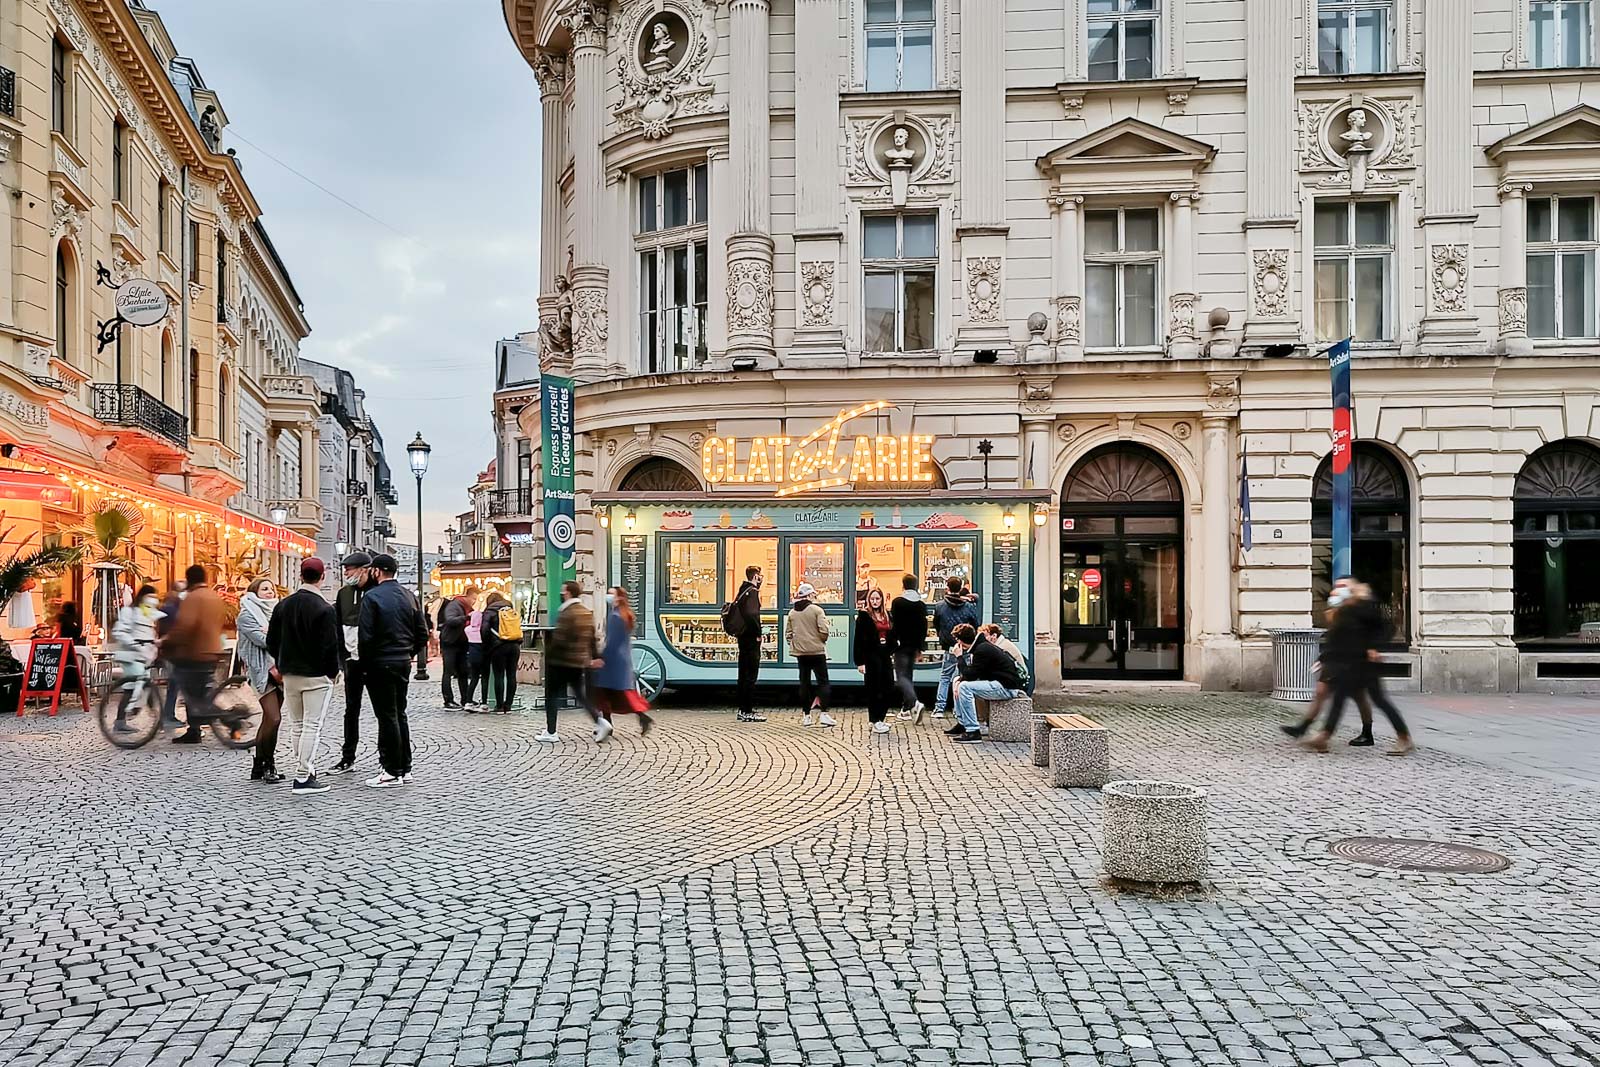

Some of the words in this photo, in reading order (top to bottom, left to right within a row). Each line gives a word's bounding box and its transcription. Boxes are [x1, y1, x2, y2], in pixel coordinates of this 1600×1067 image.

[1329, 358, 1337, 368] Art
[548, 385, 561, 431] yourself
[560, 387, 569, 424] Circles
[550, 433, 561, 477] Express
[561, 425, 571, 465] George
[702, 436, 791, 483] CLAT
[849, 436, 935, 482] ARIE
[545, 489, 557, 499] Art
[795, 512, 811, 522] CLAT
[822, 512, 839, 522] ARIE
[925, 556, 947, 567] Collect
[948, 558, 966, 567] your
[925, 567, 946, 578] order
